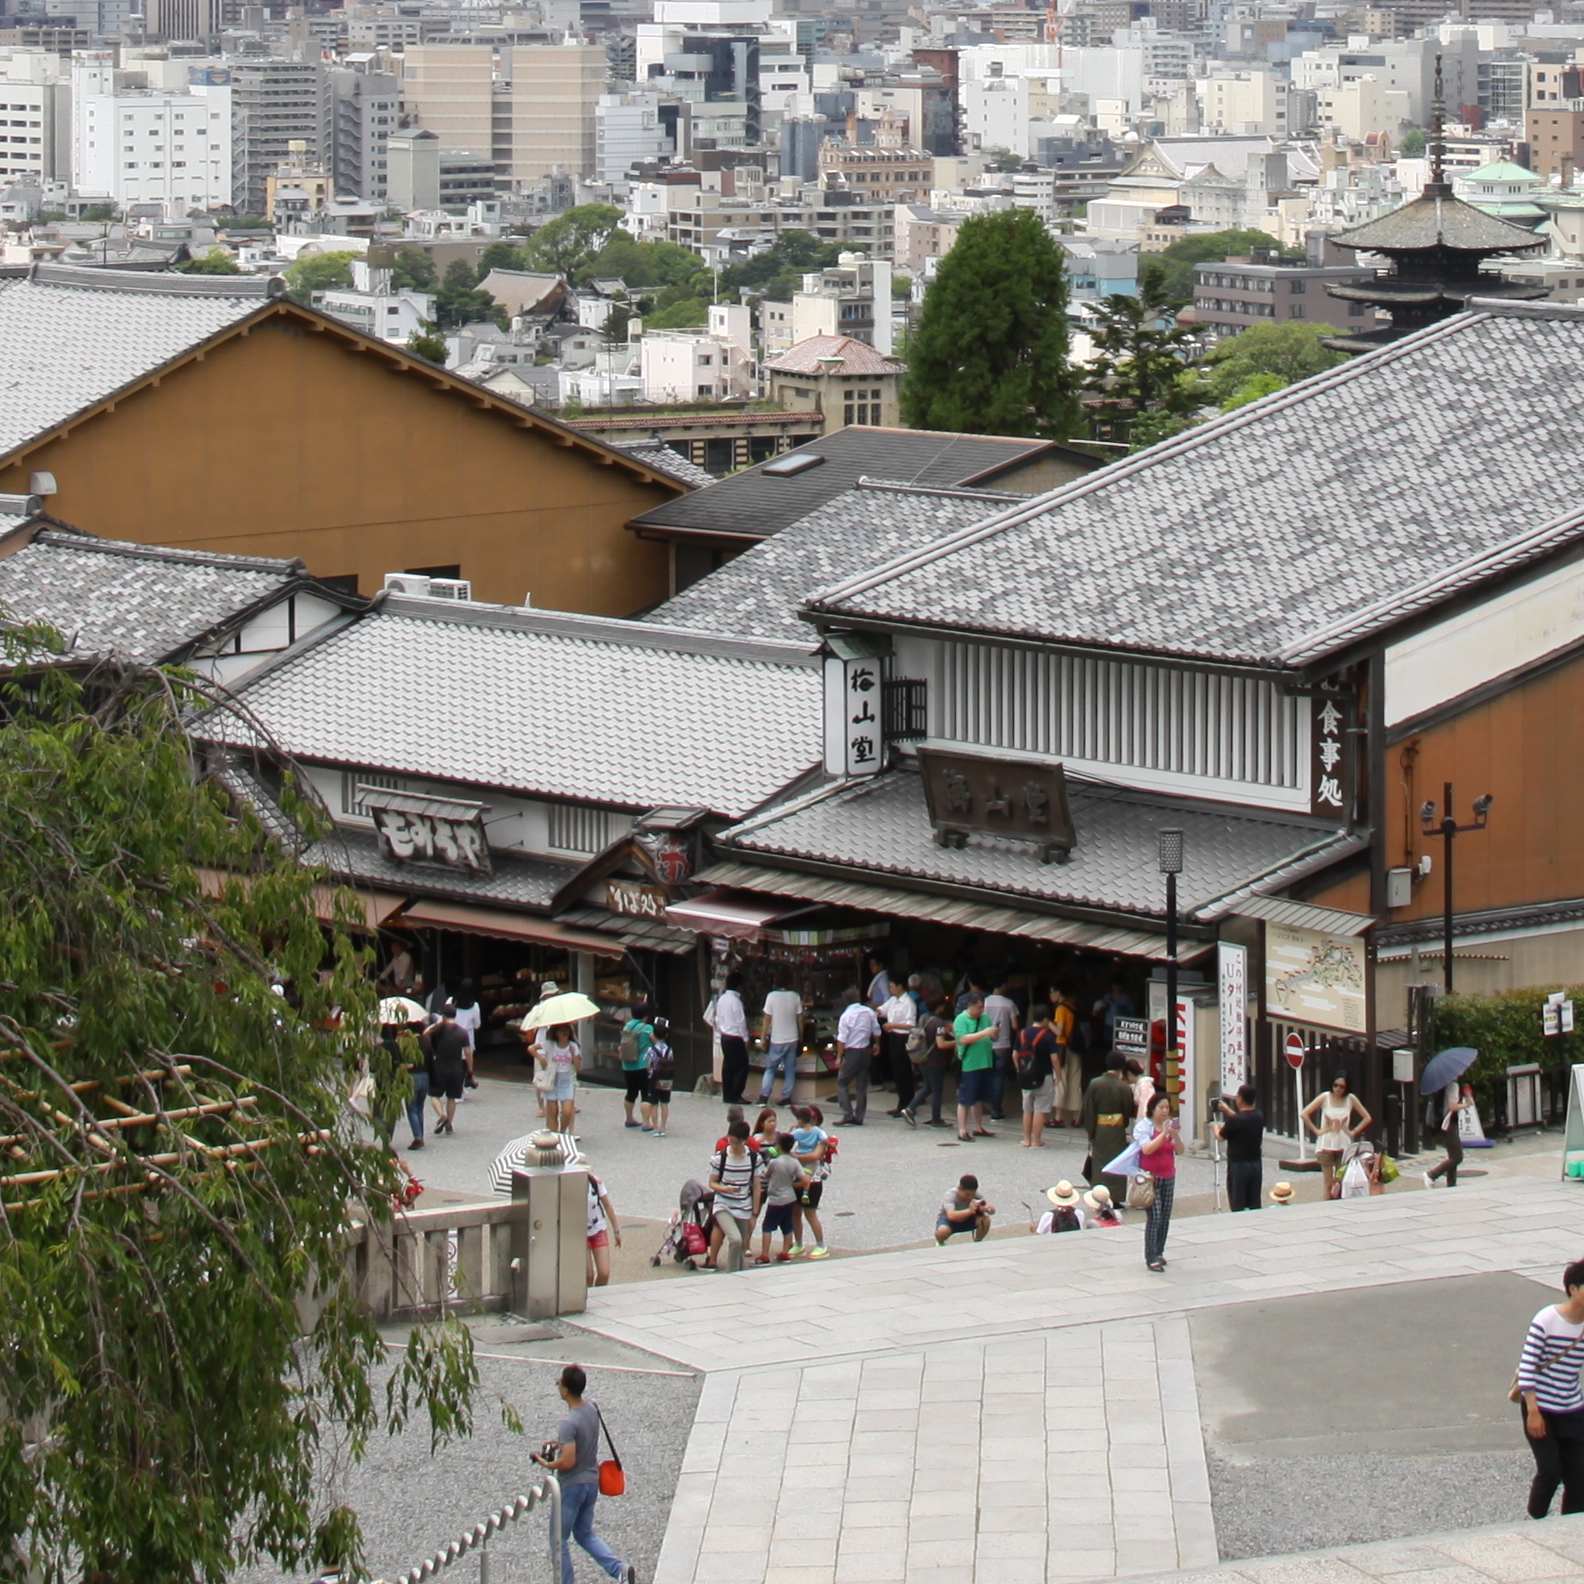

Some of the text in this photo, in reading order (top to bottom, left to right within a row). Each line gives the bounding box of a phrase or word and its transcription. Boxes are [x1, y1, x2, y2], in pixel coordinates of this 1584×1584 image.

[851, 668, 875, 763] 梅山堂
[1226, 963, 1236, 1075] Uターンのみ
